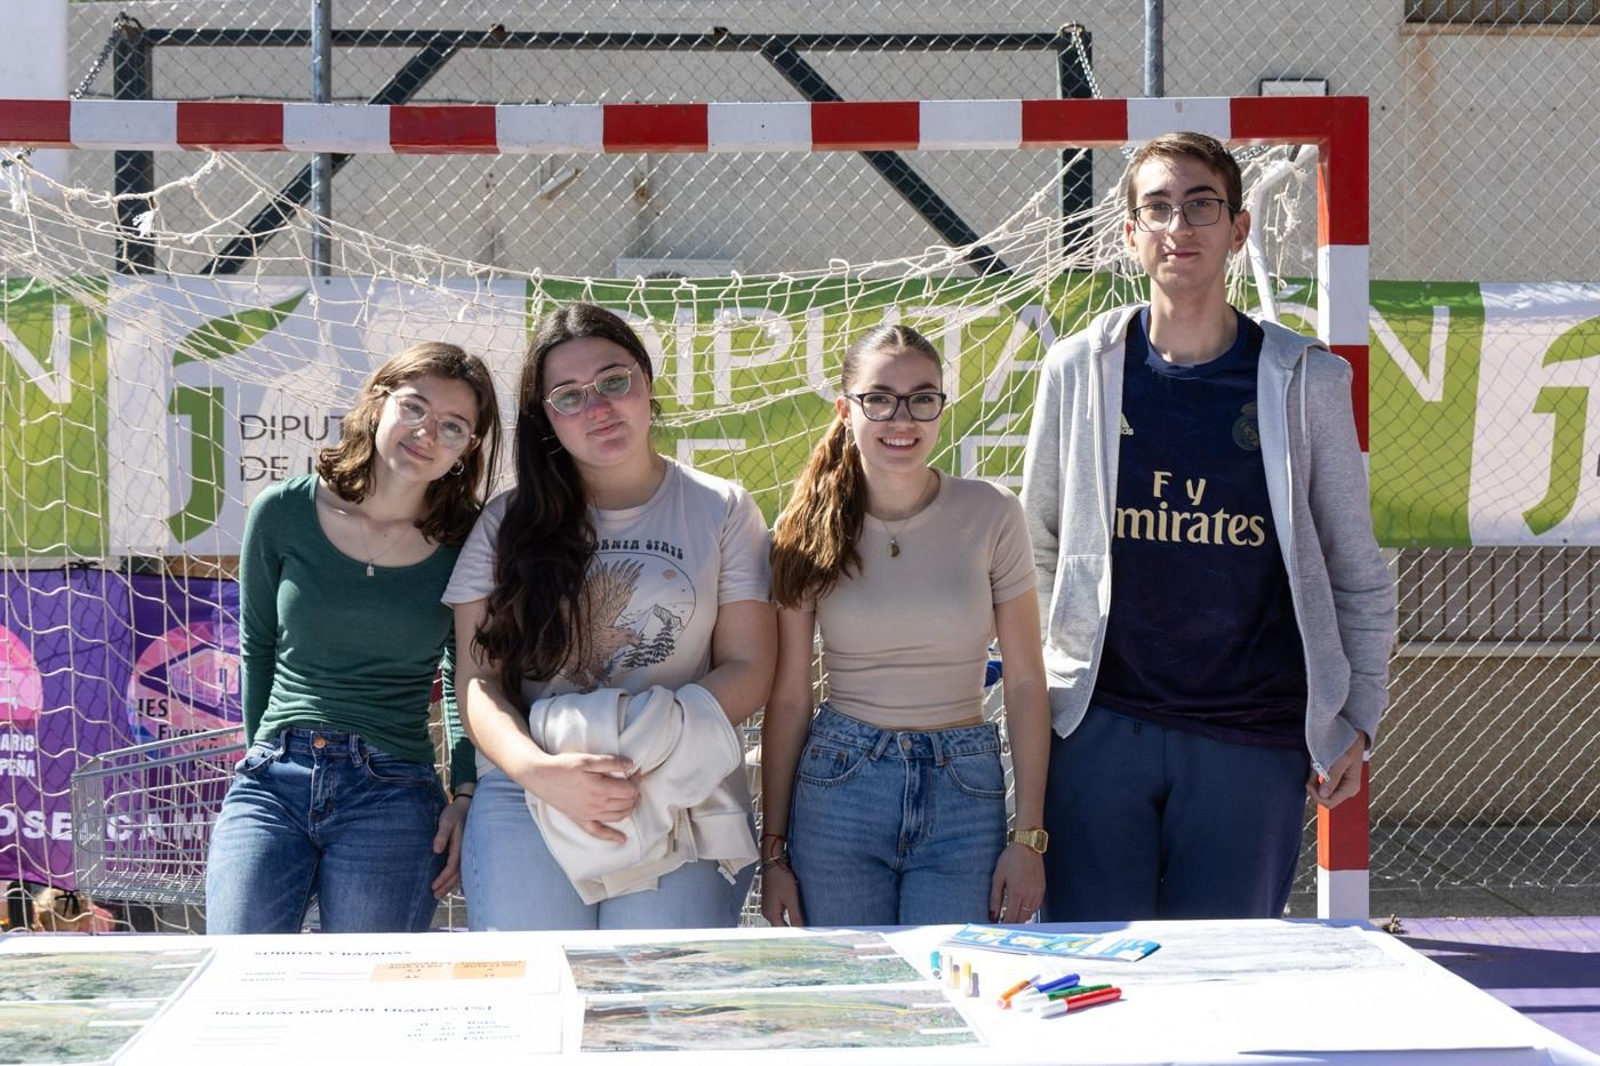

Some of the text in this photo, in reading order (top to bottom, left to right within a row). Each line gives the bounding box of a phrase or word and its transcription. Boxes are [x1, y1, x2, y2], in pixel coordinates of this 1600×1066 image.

[240, 414, 346, 441] DIPUT
[1114, 501, 1266, 547] mirates
[137, 698, 169, 718] IES
